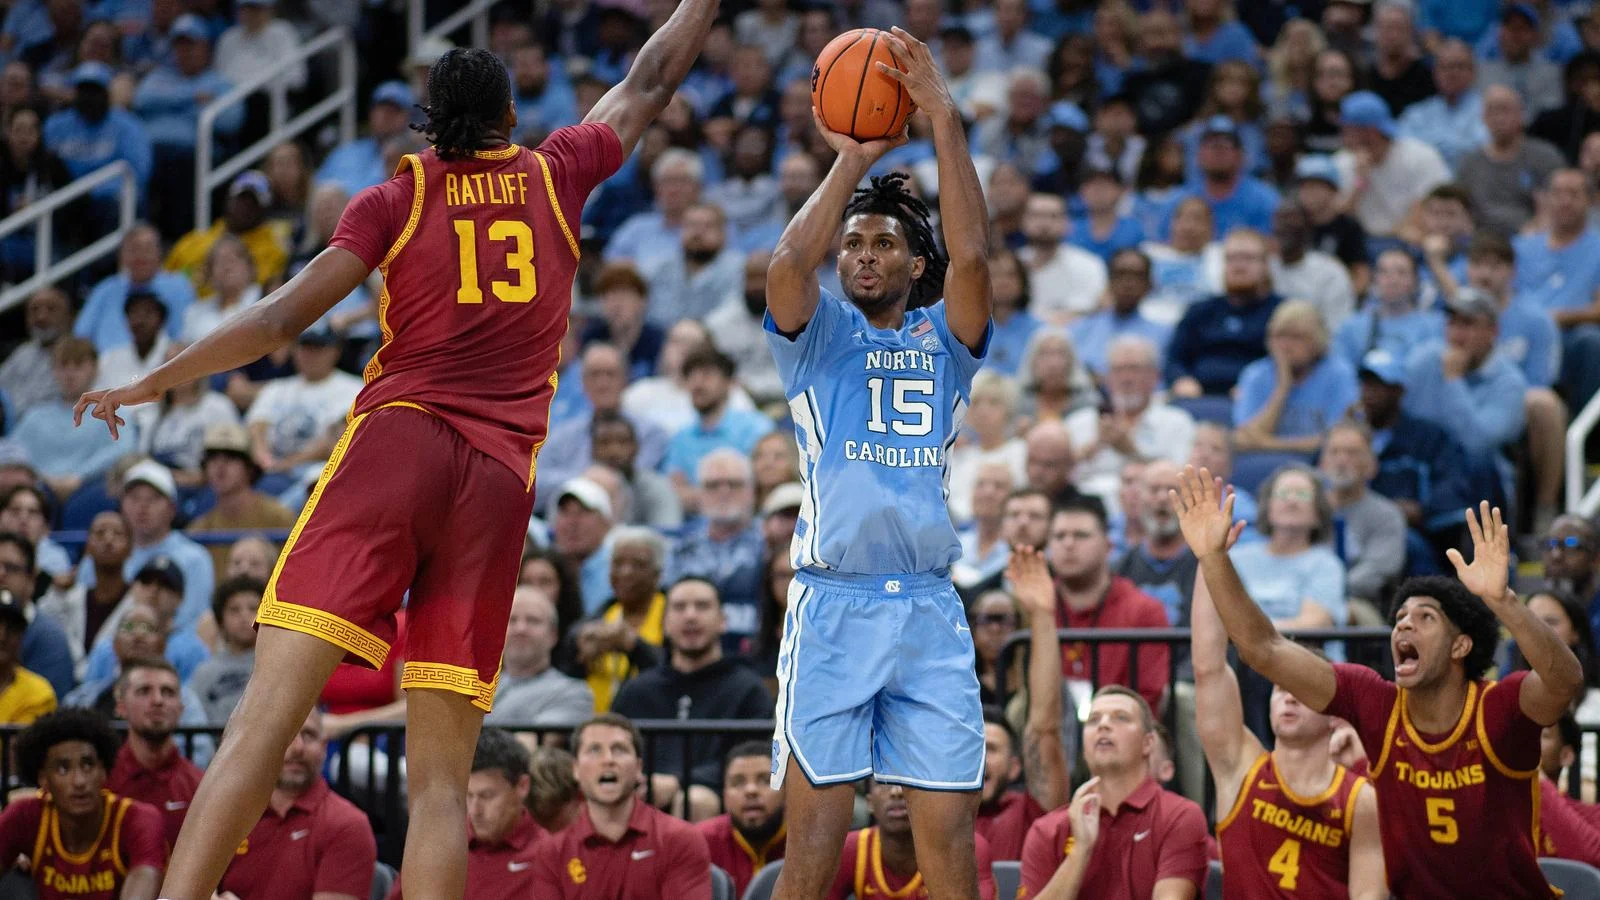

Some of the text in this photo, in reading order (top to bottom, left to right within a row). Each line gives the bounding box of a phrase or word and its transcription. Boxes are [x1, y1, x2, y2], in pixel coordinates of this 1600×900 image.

[446, 172, 528, 206] RATLIFF
[453, 219, 537, 304] 13
[865, 350, 935, 373] NORTH
[867, 377, 934, 437] 15
[845, 440, 943, 468] CAROLIN
[1252, 798, 1344, 848] TROJANS
[1425, 797, 1459, 845] 5
[43, 865, 115, 893] TOJANS
[1268, 838, 1300, 891] 4
